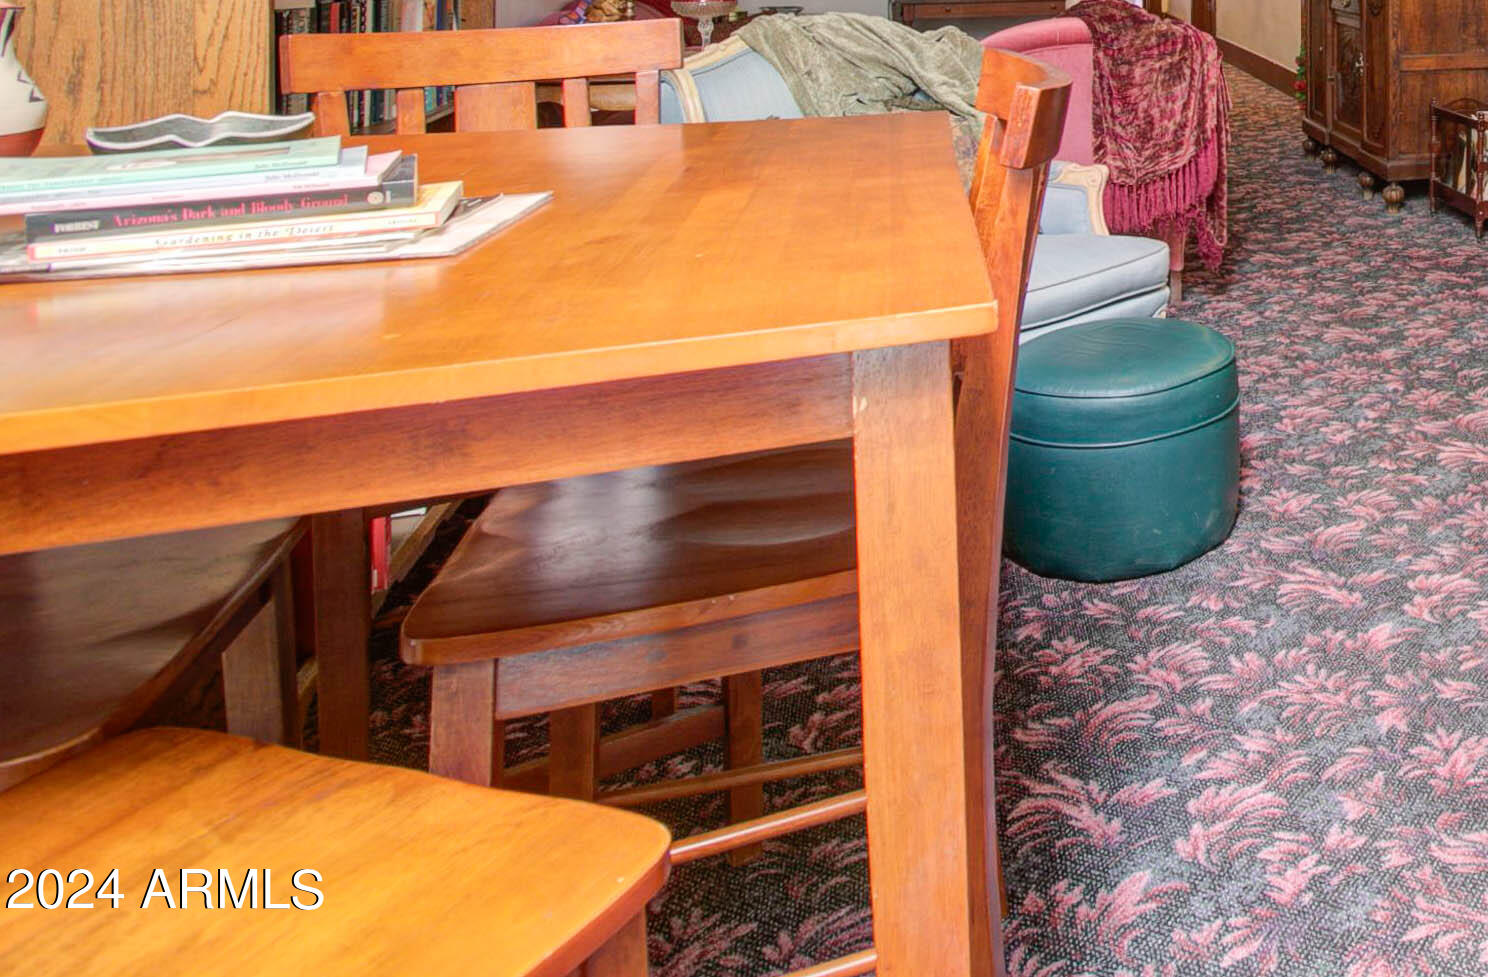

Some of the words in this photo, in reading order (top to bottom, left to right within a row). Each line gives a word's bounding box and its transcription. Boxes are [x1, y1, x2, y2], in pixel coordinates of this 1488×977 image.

[113, 208, 178, 227] Arizona's
[181, 204, 217, 222] Dark
[220, 202, 246, 217] and
[251, 198, 294, 215] Bloody
[301, 193, 348, 208] Ground
